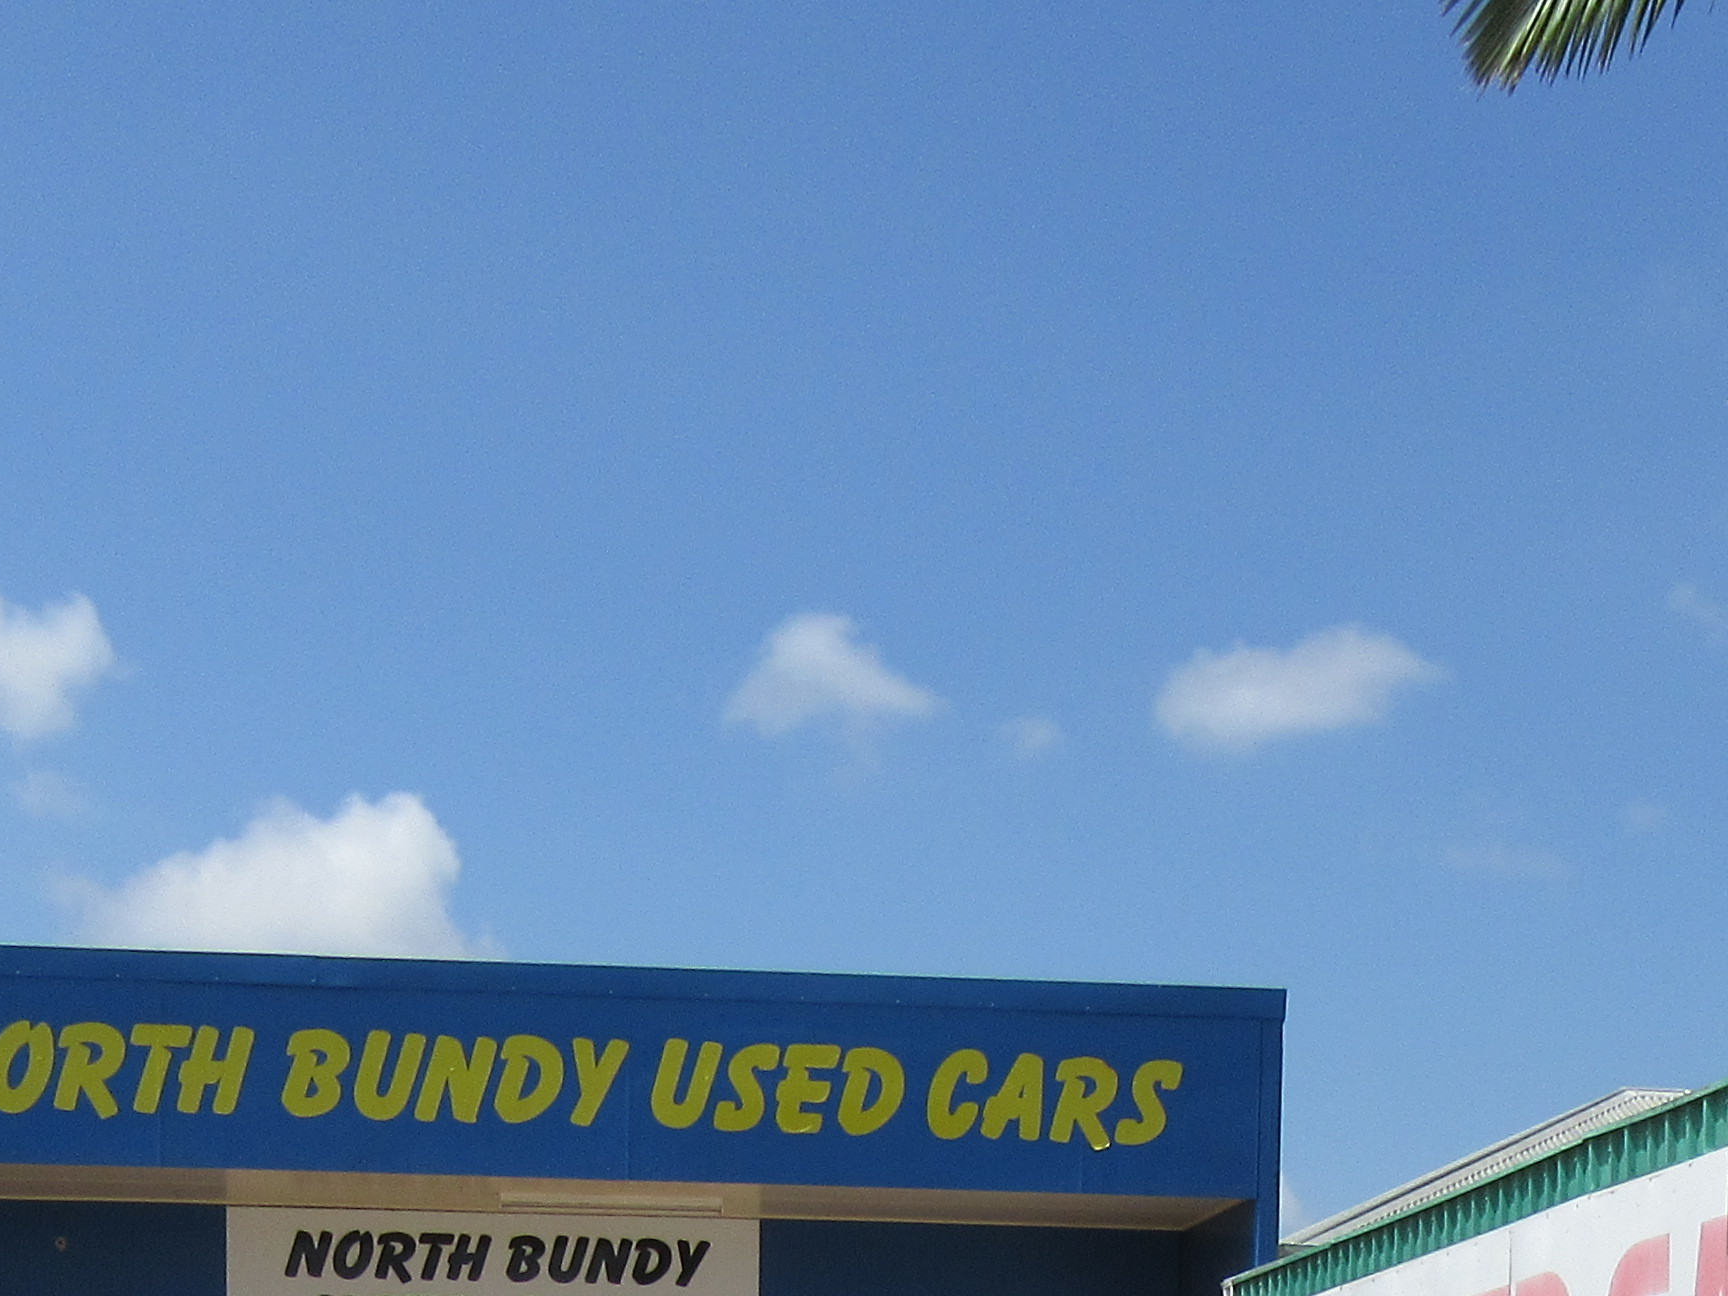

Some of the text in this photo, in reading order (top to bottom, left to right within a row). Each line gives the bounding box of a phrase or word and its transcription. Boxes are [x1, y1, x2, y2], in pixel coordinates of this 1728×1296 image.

[281, 1028, 630, 1127] BUNDY
[650, 1038, 906, 1137] USED
[927, 1049, 1183, 1151] CARS
[285, 1231, 710, 1287] NORTH BUNDY
